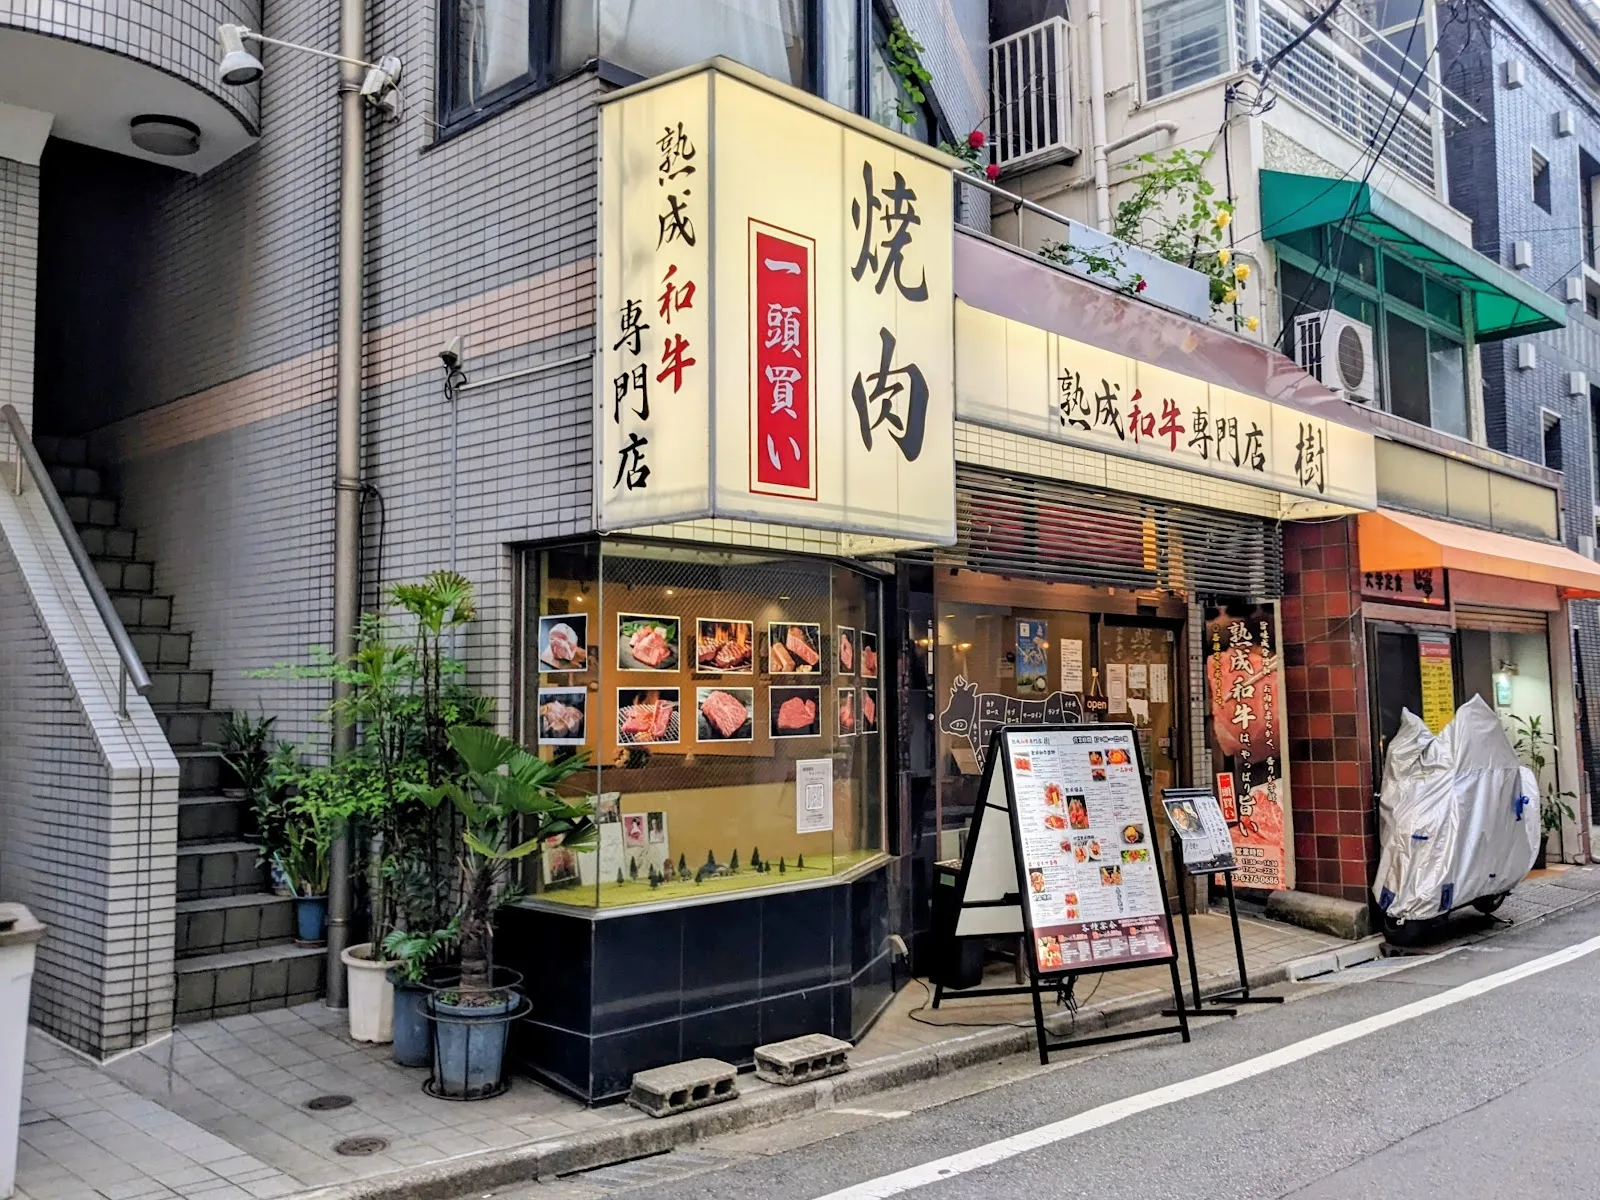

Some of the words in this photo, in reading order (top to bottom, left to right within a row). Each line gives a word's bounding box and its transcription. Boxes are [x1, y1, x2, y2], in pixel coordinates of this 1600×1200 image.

[656, 121, 697, 394] 熟成和牛
[851, 160, 929, 462] 焼肉
[613, 299, 650, 491] 専門店
[764, 257, 801, 471] 一頭買い
[1057, 367, 1266, 473] 熟成和牛専門店
[1294, 422, 1325, 494] 樹
[1087, 701, 1107, 711] open
